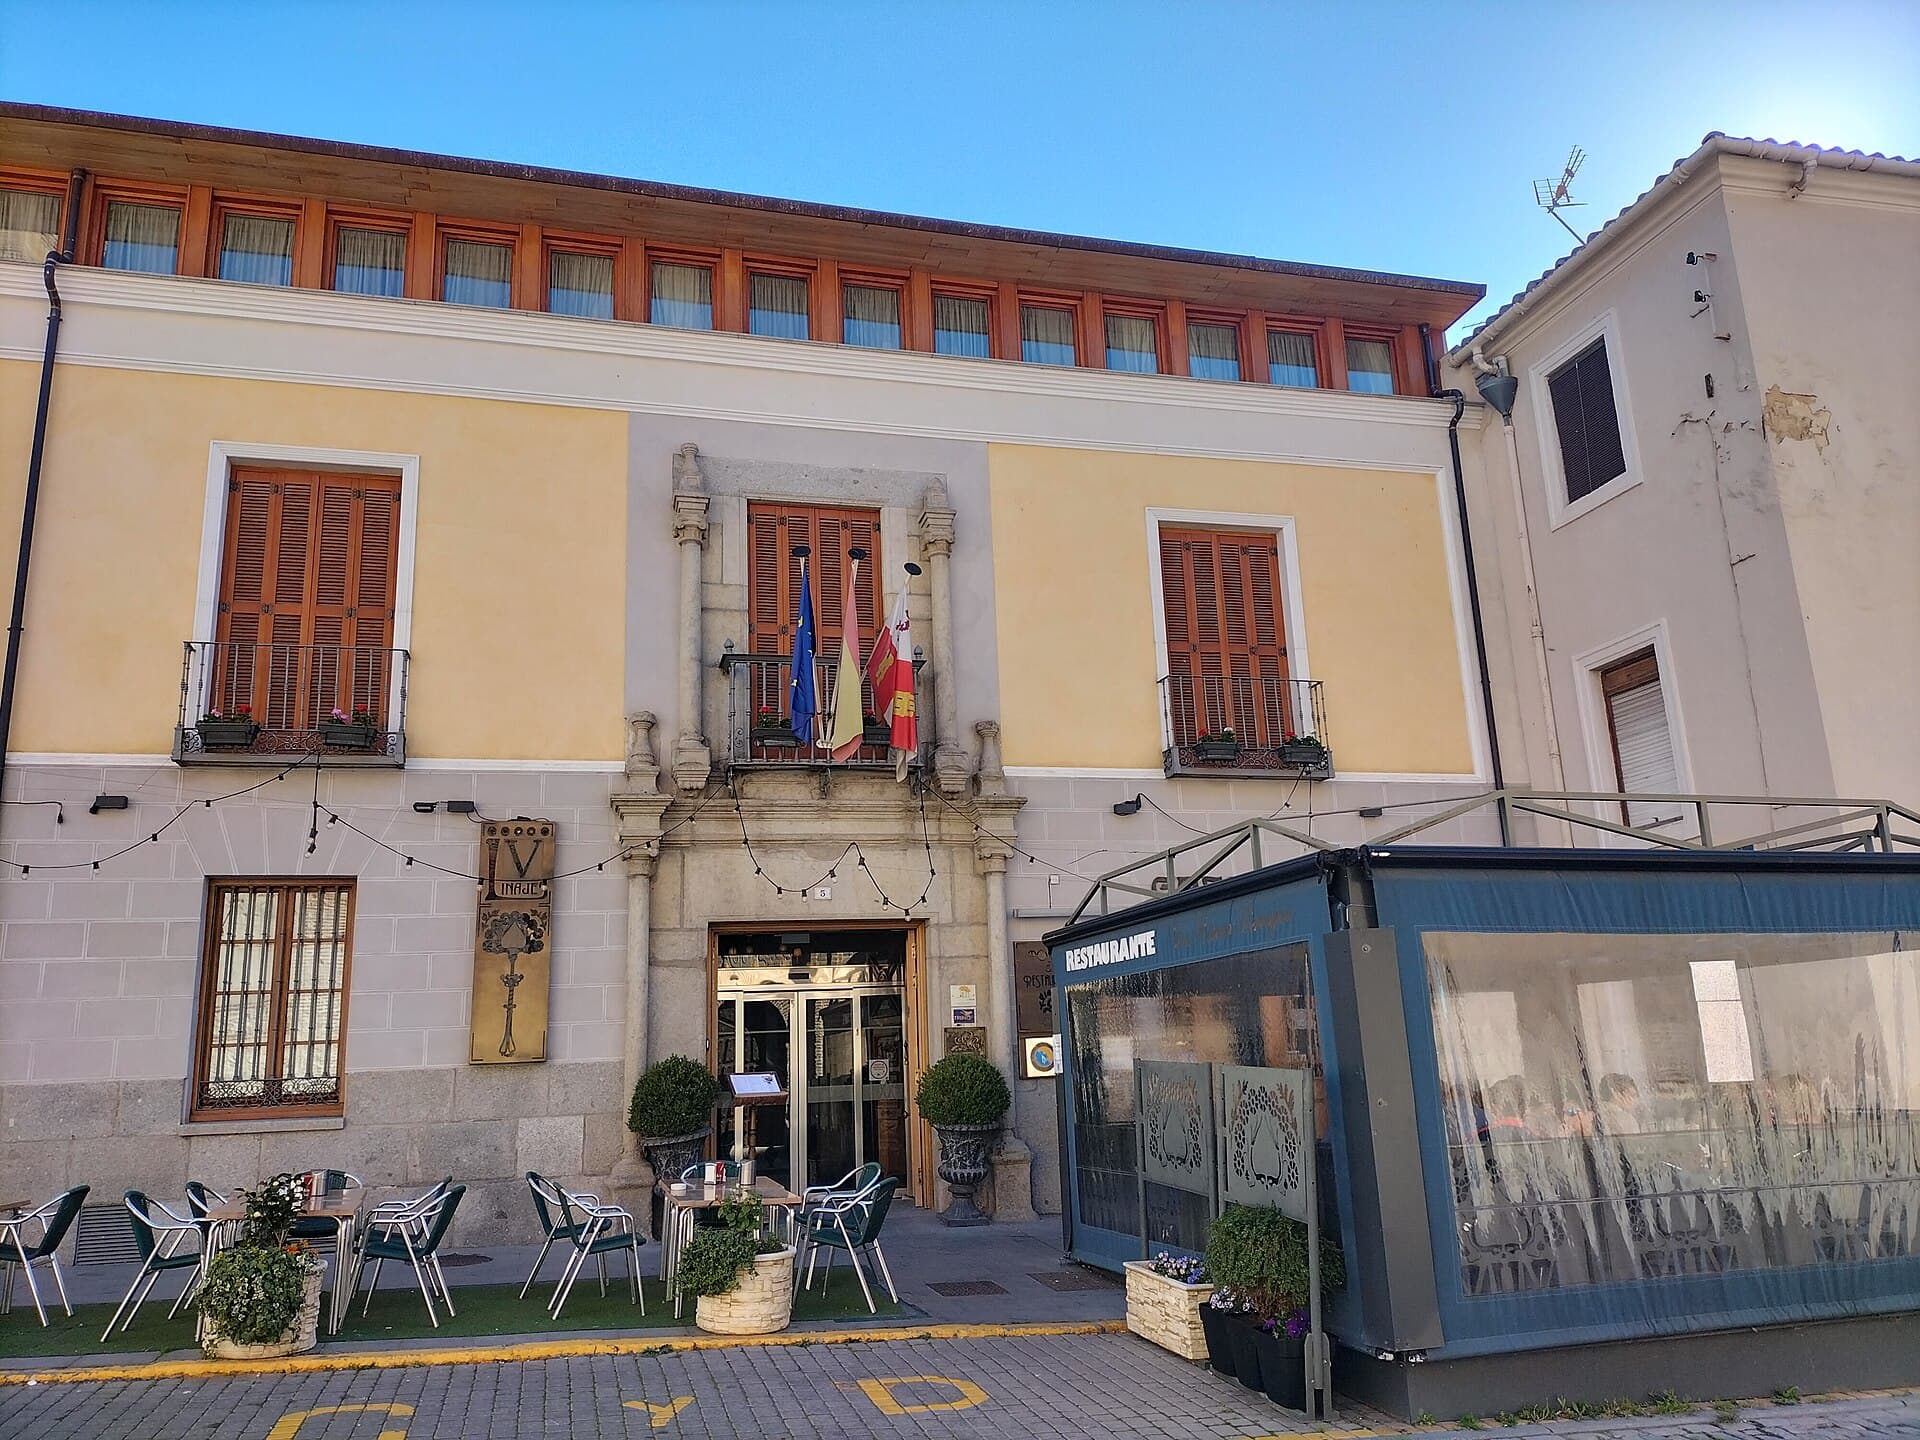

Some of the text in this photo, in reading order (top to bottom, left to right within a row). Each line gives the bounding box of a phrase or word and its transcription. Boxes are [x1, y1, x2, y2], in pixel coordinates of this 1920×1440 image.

[820, 889, 826, 898] 5
[1065, 929, 1157, 972] RESTAURANTE
[623, 1396, 695, 1428] Y
[855, 1375, 990, 1415] D
